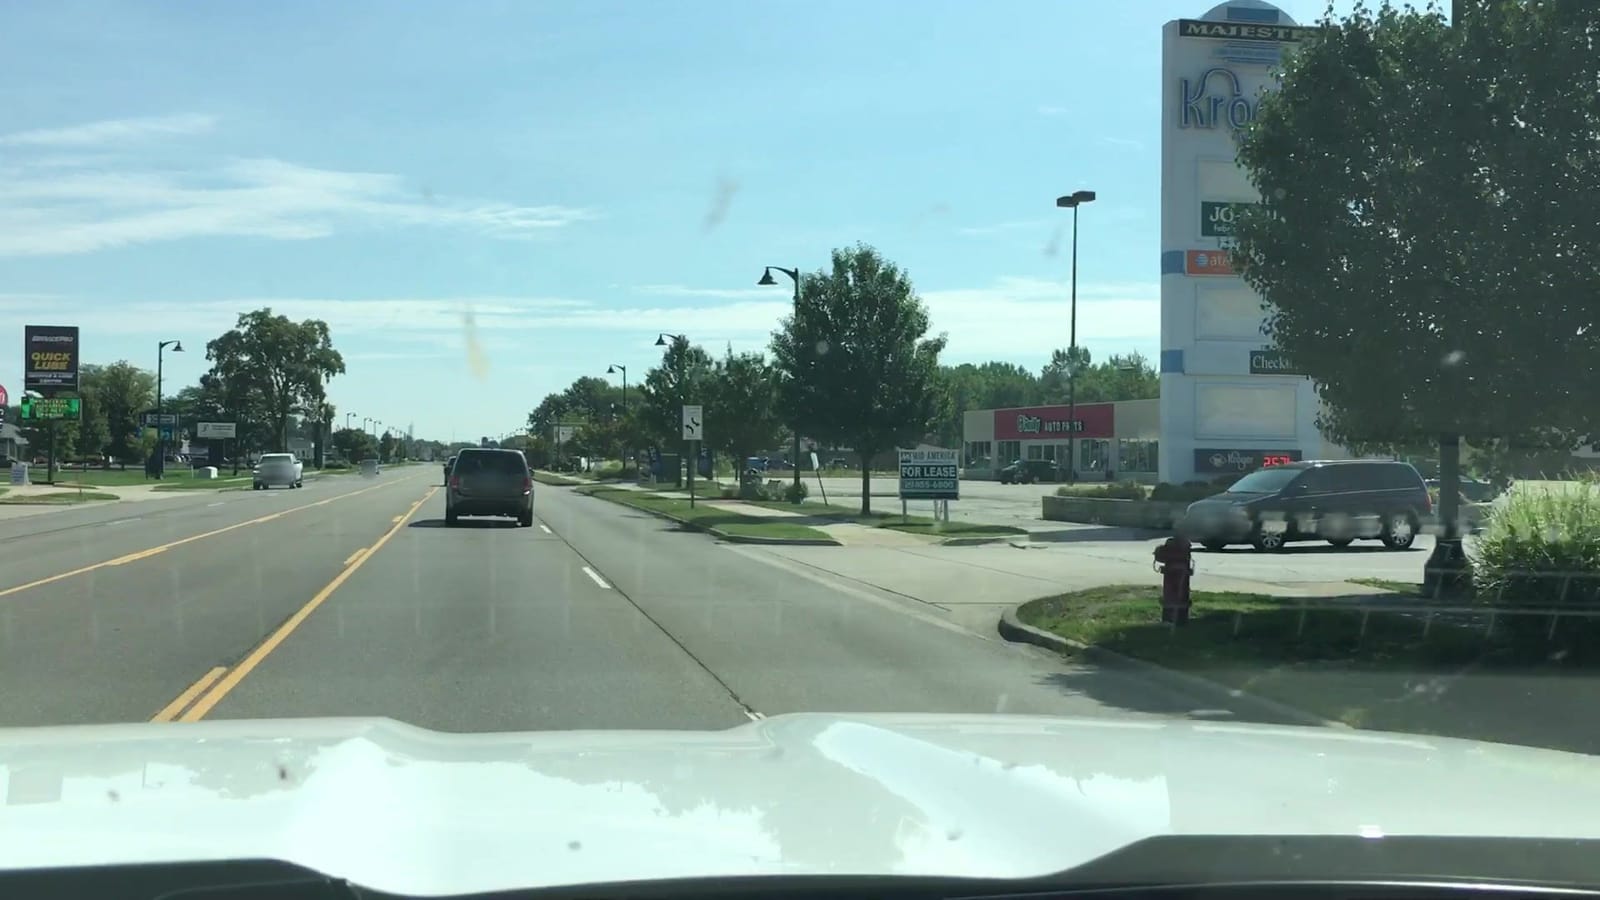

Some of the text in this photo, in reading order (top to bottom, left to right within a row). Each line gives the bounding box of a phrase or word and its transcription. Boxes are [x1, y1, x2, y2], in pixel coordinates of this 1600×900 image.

[1180, 67, 1261, 130] Kro
[31, 352, 71, 361] QUICK
[34, 361, 68, 370] LUBE
[1061, 420, 1083, 432] PATS
[901, 466, 956, 477] FOR LEASE
